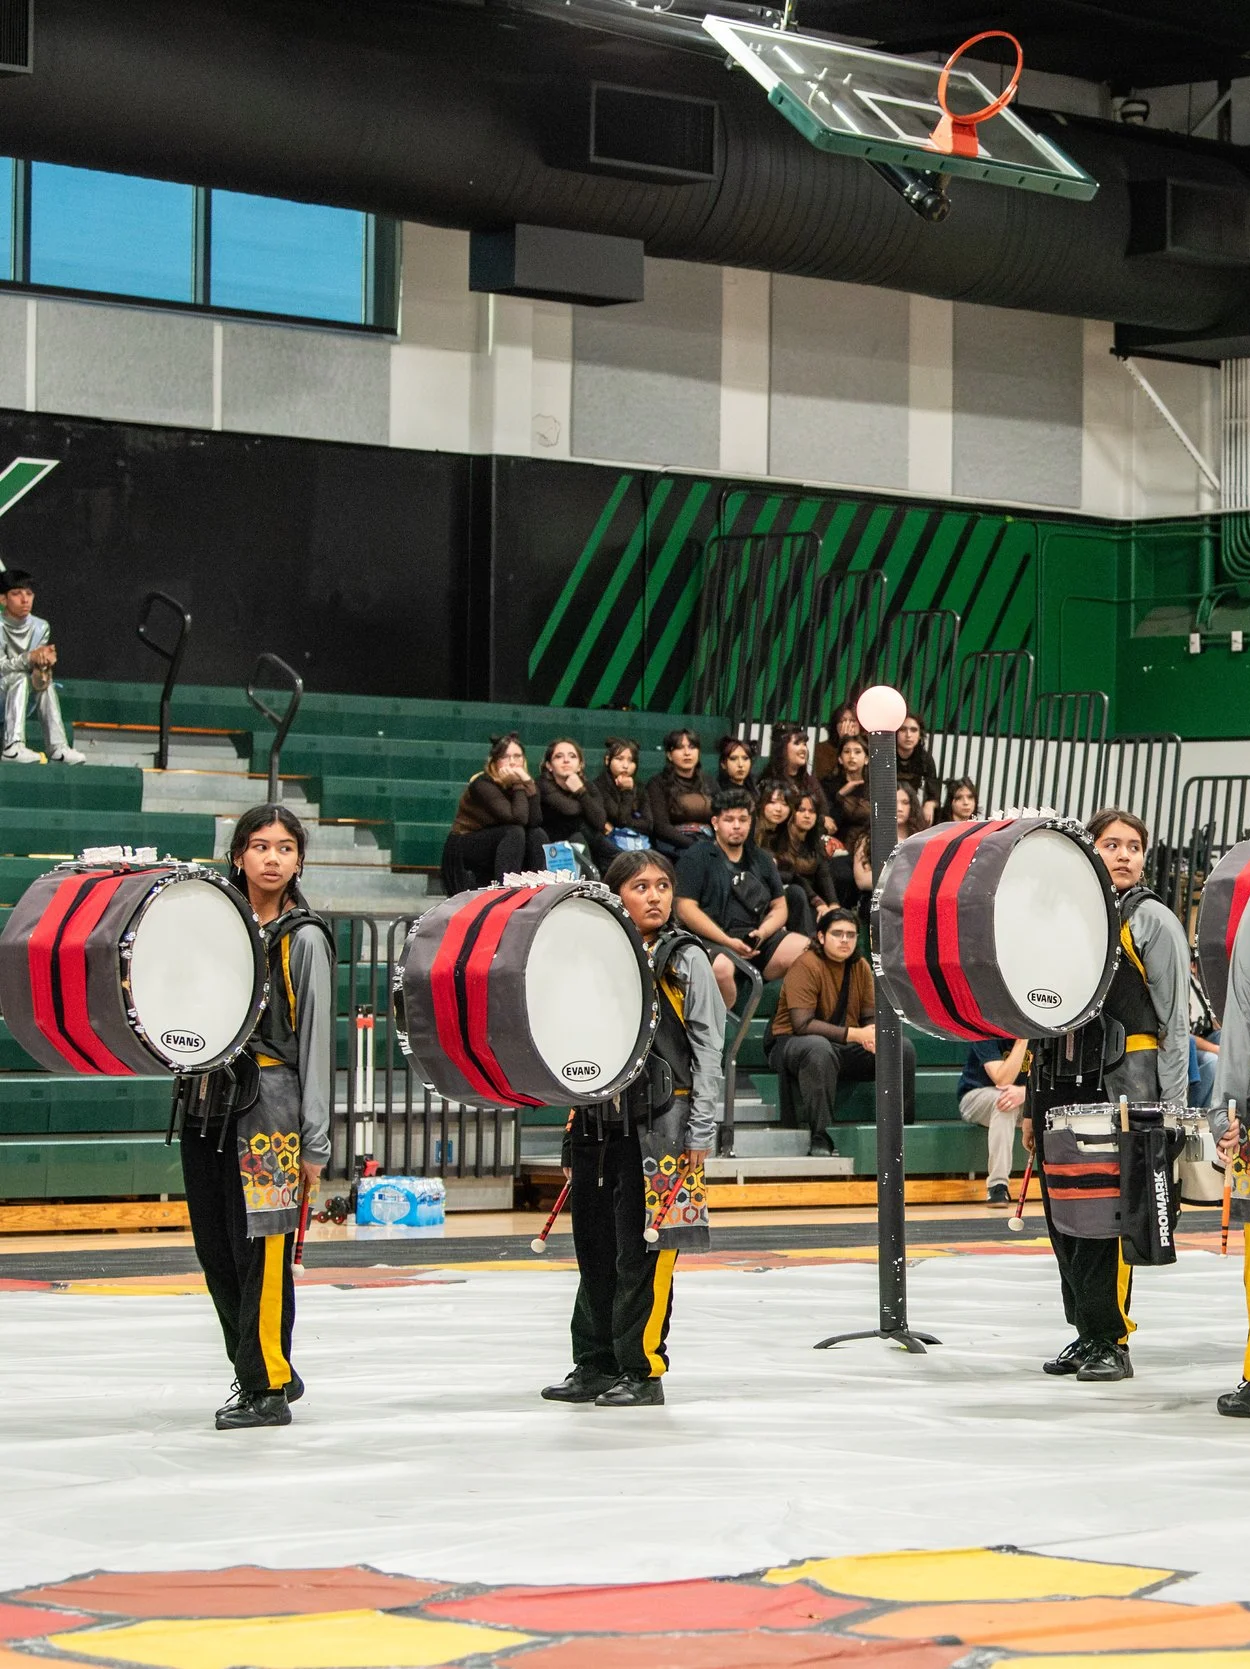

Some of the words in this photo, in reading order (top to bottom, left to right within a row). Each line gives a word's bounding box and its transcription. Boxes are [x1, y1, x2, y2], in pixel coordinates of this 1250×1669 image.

[1031, 992, 1058, 1004] EVANS
[165, 1034, 200, 1048] EVANS
[566, 1066, 596, 1076] EVANS
[1153, 1169, 1170, 1248] PROMARK
